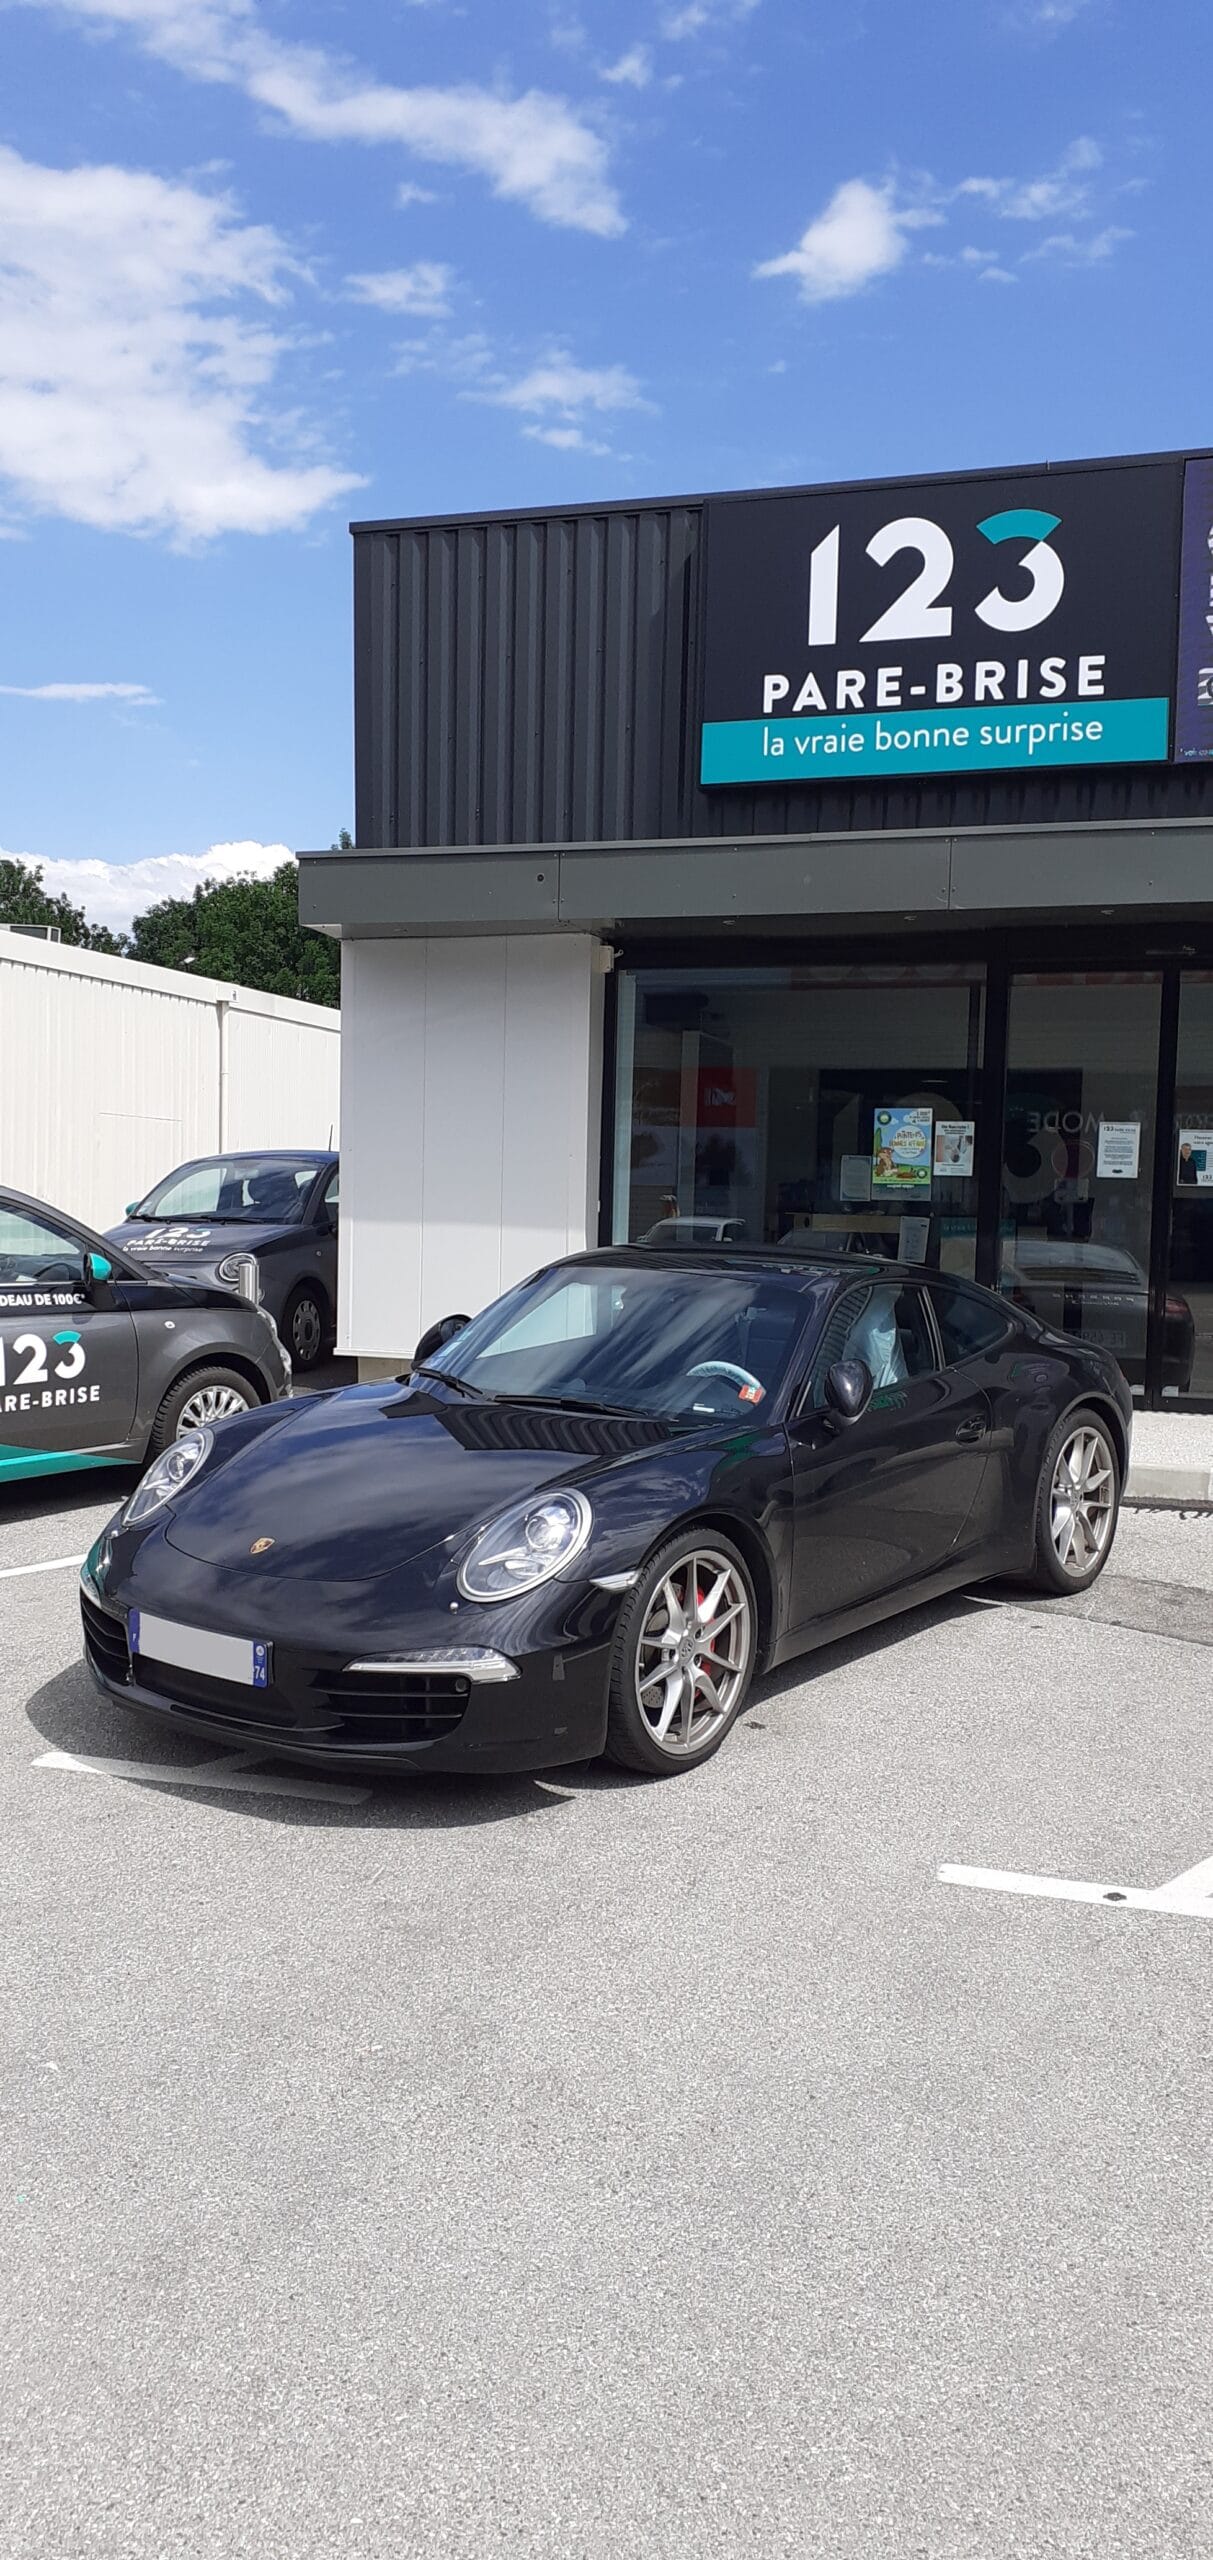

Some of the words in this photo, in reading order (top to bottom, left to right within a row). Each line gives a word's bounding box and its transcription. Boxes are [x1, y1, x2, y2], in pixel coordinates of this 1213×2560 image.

[807, 508, 1065, 646] 123
[762, 655, 1106, 714] PARE-BRISE
[763, 726, 785, 757] la
[794, 723, 865, 755] vraie
[875, 720, 970, 751] bonne
[980, 711, 1103, 755] surprise
[126, 1239, 210, 1247] PARE-BRISE
[34, 1293, 52, 1306] DE
[0, 1385, 100, 1413] RE-BRISE
[254, 1666, 265, 1681] 74
